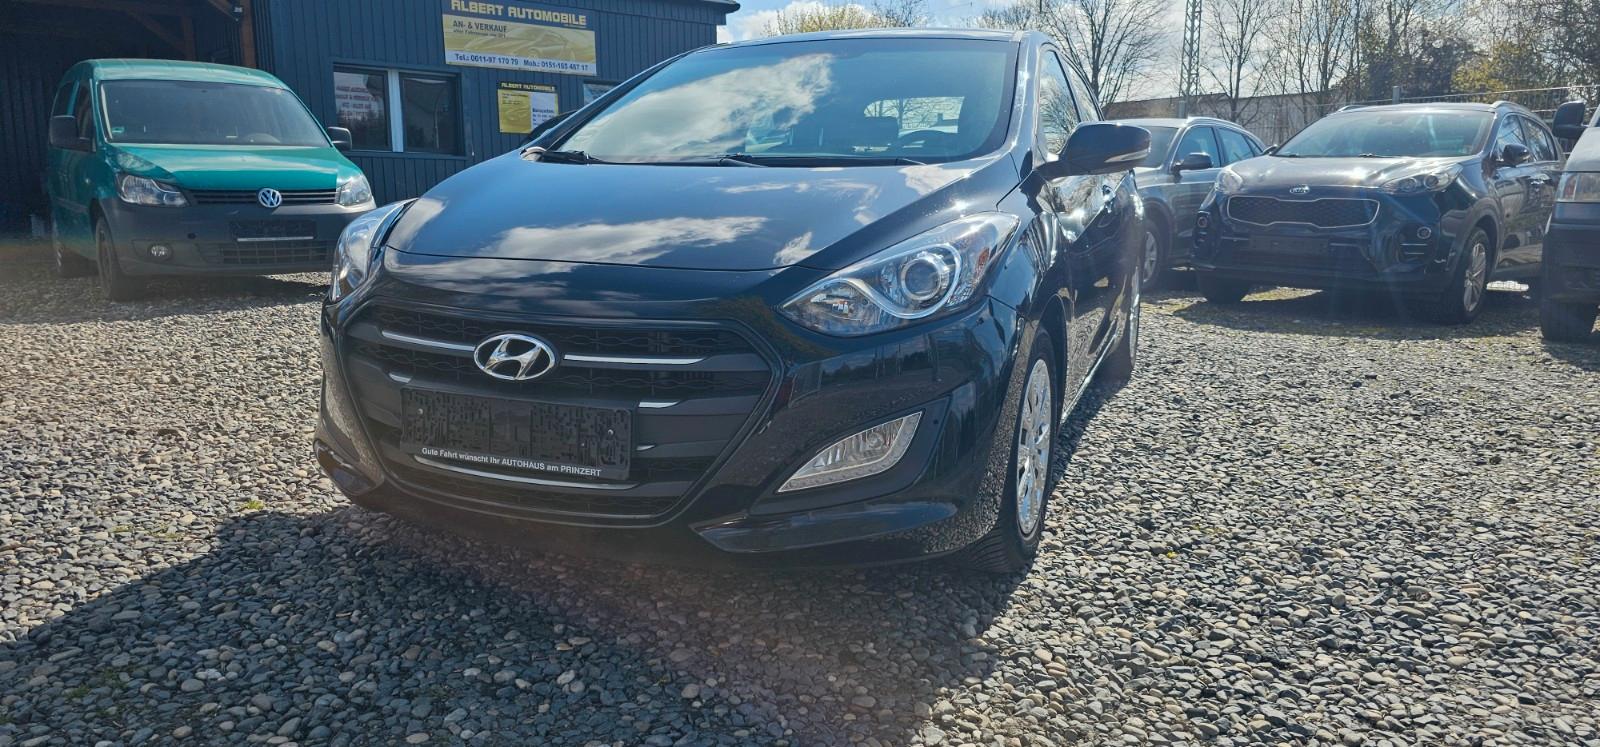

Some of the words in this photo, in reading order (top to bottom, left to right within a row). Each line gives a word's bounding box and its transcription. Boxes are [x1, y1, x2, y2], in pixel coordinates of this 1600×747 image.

[451, 0, 504, 15] ALBERT
[508, 6, 587, 25] AUTOMOBILE
[468, 21, 473, 29] &
[474, 22, 507, 33] VERKAUF
[422, 447, 438, 456] Gute
[440, 449, 458, 459] Fahrt
[459, 452, 488, 463] wünscht
[490, 455, 501, 464] Ihr
[502, 458, 545, 470] AUTOHAUS
[560, 465, 602, 477] PRINZERT
